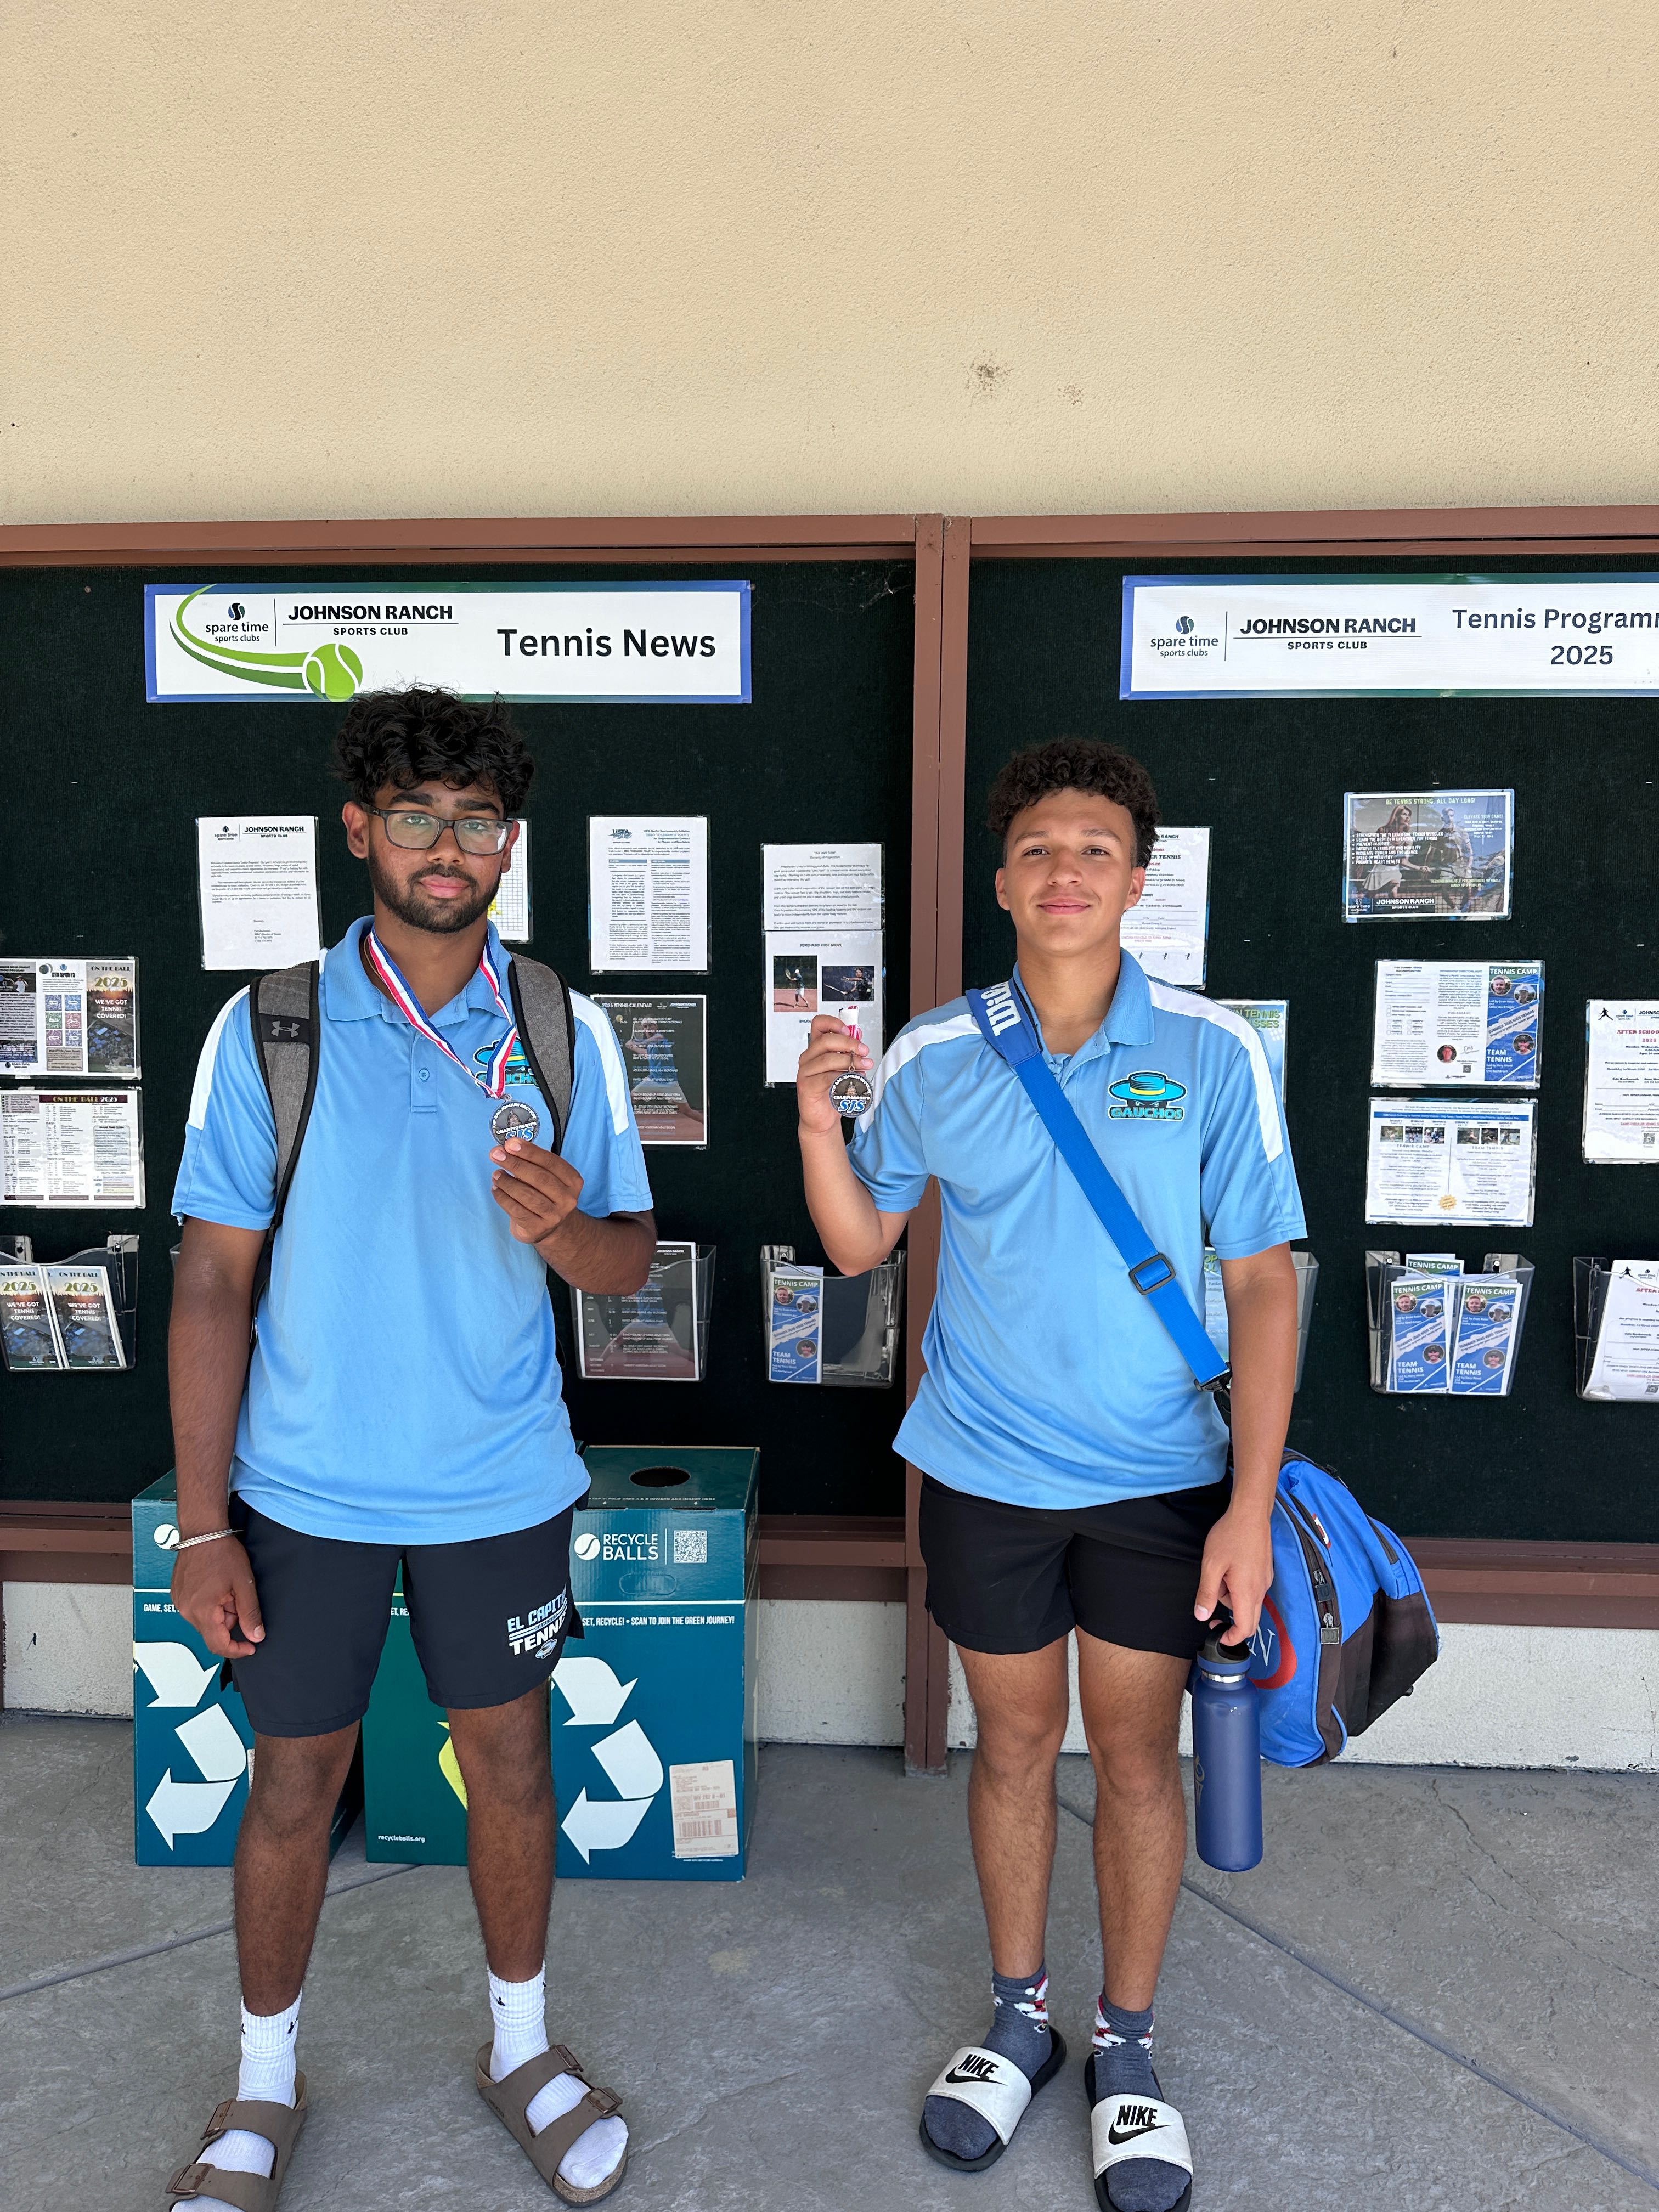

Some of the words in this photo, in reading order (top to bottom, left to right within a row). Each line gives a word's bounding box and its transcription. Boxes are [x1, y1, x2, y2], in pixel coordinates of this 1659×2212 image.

[288, 605, 381, 620] JOHNSON
[386, 605, 453, 620] RANCH
[1240, 618, 1340, 634] JOHNSON
[1344, 618, 1415, 633] RANCH
[1452, 608, 1536, 629] Tennis
[1545, 608, 1659, 634] Program
[206, 623, 238, 634] spare
[241, 622, 269, 633] time
[380, 627, 408, 635] CLUB
[215, 635, 238, 643] sports
[240, 634, 260, 642] clubs
[497, 628, 611, 657] Tennis
[624, 629, 716, 657] News
[1150, 637, 1186, 648] spare
[1189, 635, 1218, 647] time
[1287, 642, 1333, 650] SPORTS
[1338, 641, 1367, 650] CLUB
[1160, 650, 1185, 658] sports
[1187, 648, 1208, 657] clubs
[1551, 645, 1613, 665] 2025
[94, 977, 128, 988] 2025
[1244, 1009, 1280, 1019] TENNIS
[1254, 1020, 1279, 1028] SSES
[476, 1073, 536, 1085] GUCH
[838, 1099, 867, 1113] SJS
[1110, 1107, 1183, 1120] GAUCHOS
[2, 1282, 36, 1291] 2025
[64, 1282, 98, 1292] 2025
[604, 1534, 658, 1545] RECYCLE
[603, 1546, 658, 1560] BALLS
[144, 1604, 163, 1613] GAME,
[163, 1604, 177, 1613] SET,
[391, 1607, 399, 1616] ET,
[507, 1616, 524, 1633] EL
[528, 1593, 564, 1626] CAPIT
[582, 1617, 595, 1627] SET,
[596, 1617, 625, 1626] RECYCLE!
[631, 1617, 647, 1625] SCAN
[648, 1617, 657, 1625] TO
[657, 1617, 671, 1625] JOIN
[672, 1616, 684, 1624] THE
[685, 1616, 704, 1624] GREEN
[706, 1616, 735, 1624] JOURNEY!
[378, 1835, 426, 1843] recycleballs.org
[958, 2053, 1000, 2080] NIKE
[1116, 2104, 1158, 2129] NIKE
